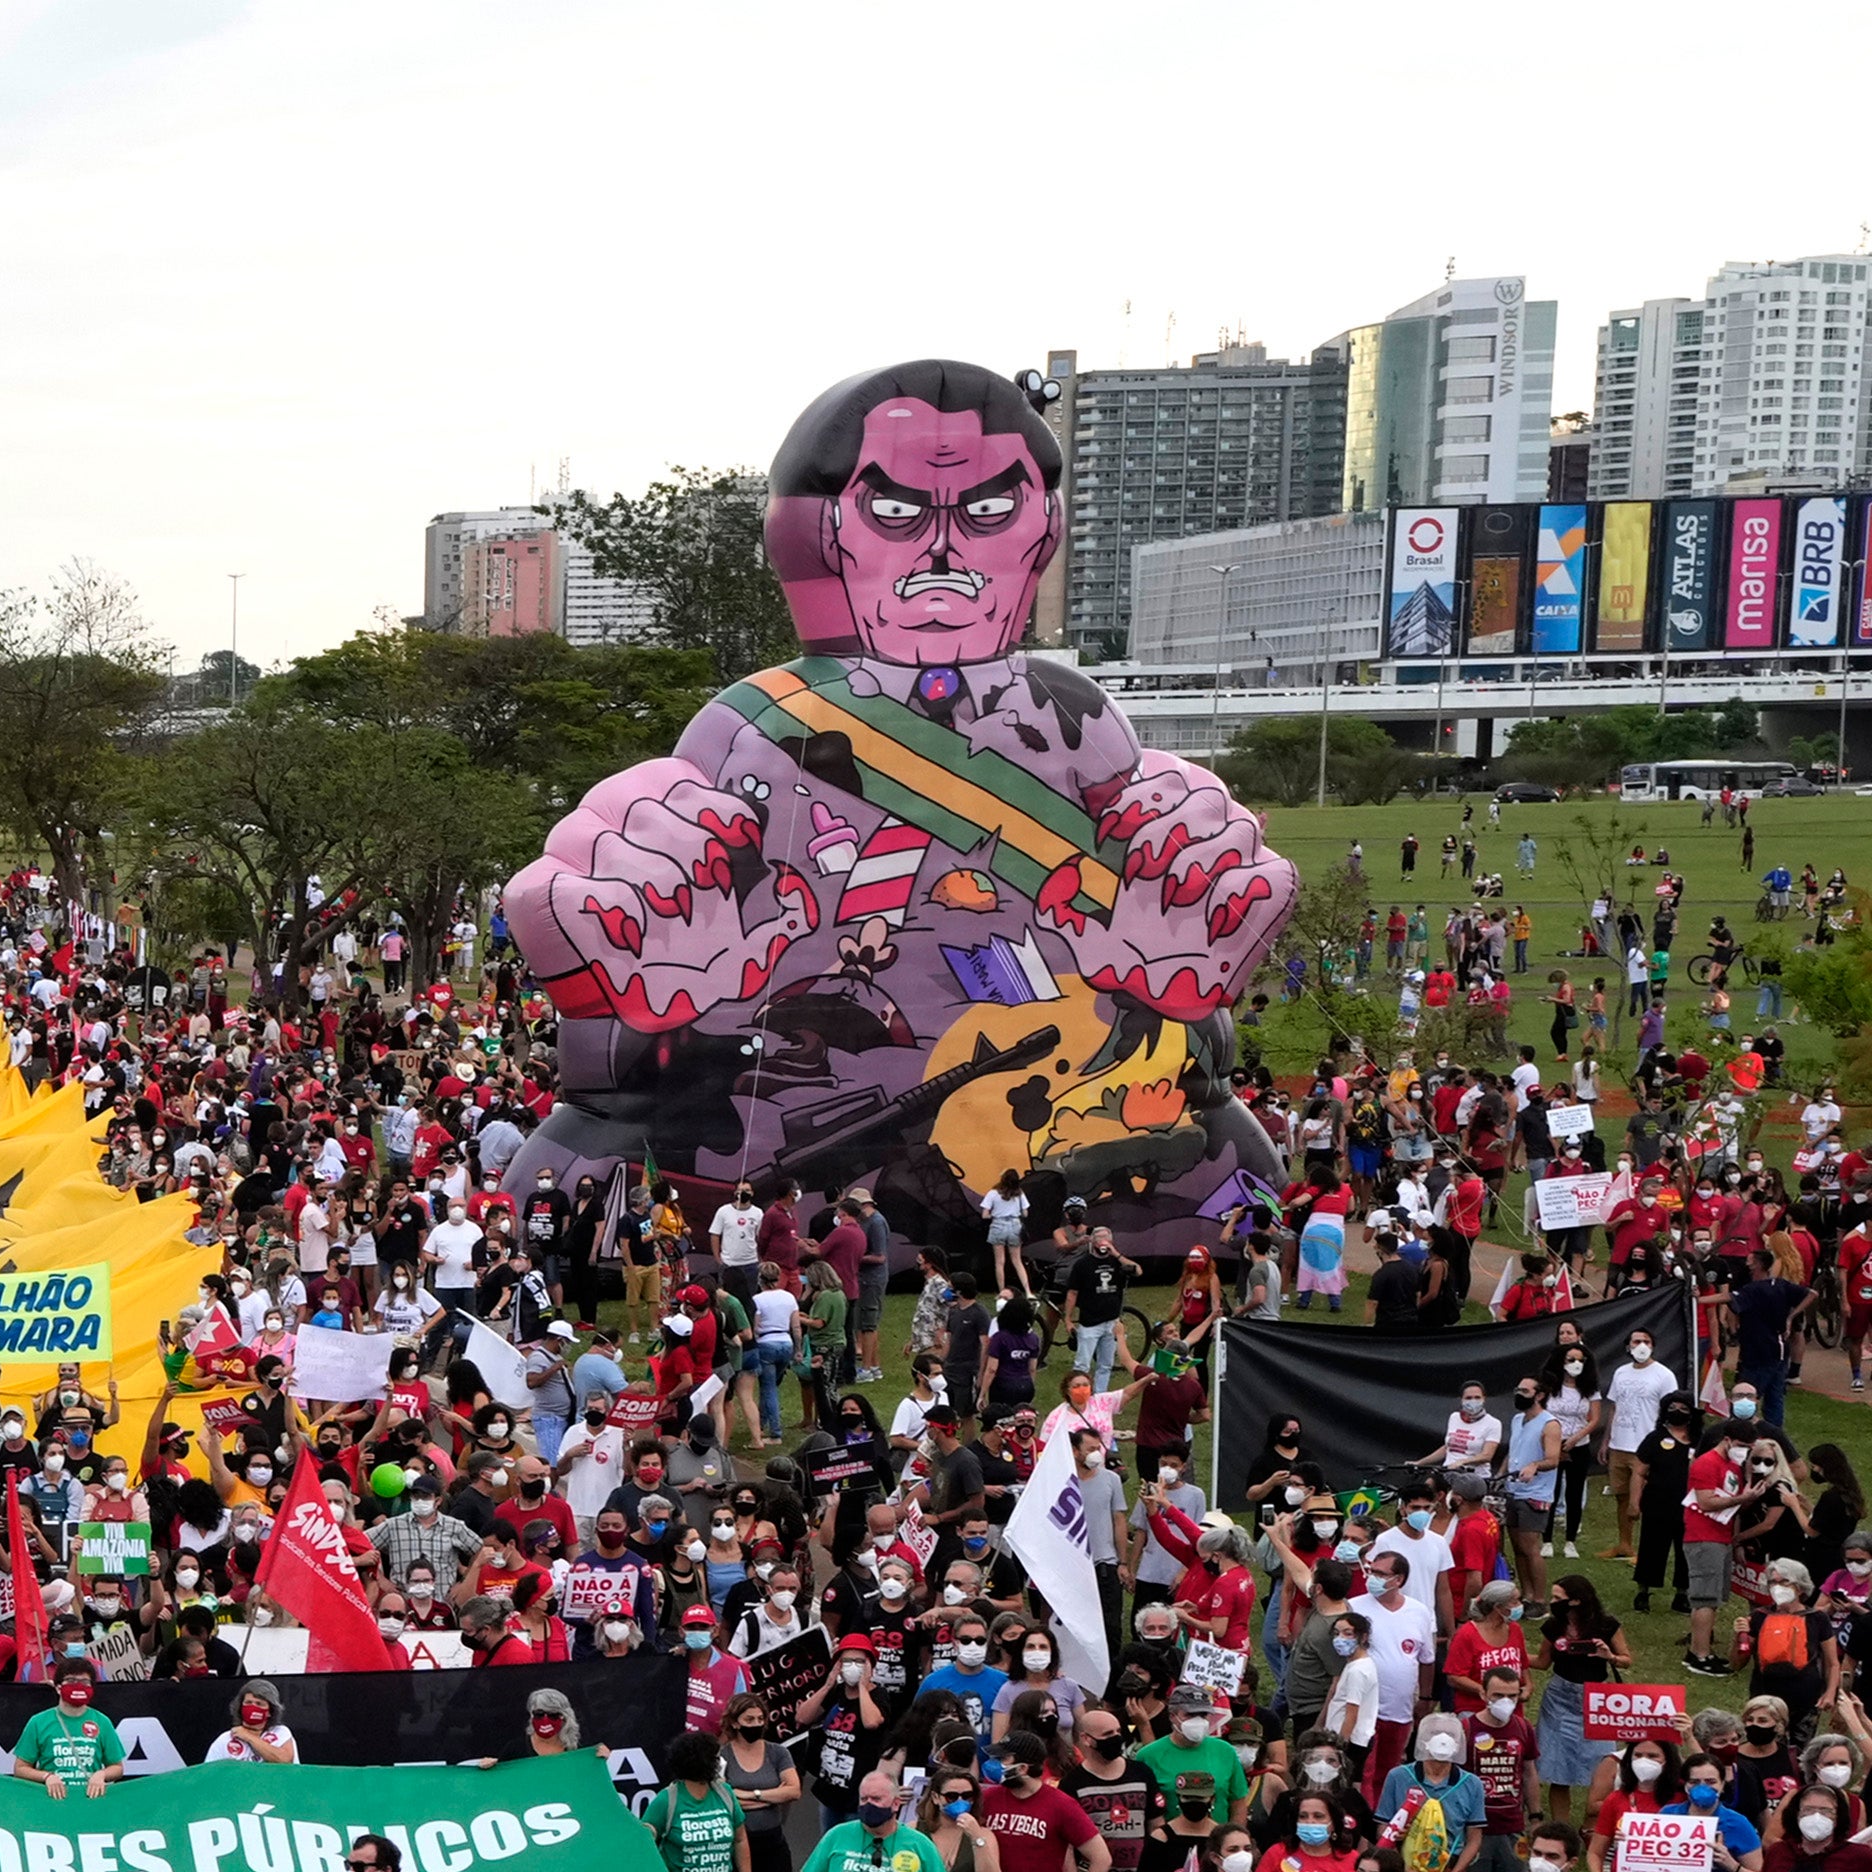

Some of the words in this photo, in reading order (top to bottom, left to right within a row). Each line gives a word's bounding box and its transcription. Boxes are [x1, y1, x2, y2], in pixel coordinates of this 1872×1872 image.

[1406, 554, 1444, 566] Brasal
[1672, 514, 1697, 600] ATLAS
[1801, 519, 1834, 588] BRB
[1737, 516, 1771, 631] marisa
[1536, 604, 1579, 617] CAIXA
[573, 1576, 612, 1592] NÃO
[572, 1591, 608, 1606] PEC
[1589, 1692, 1674, 1716] FORA
[1588, 1713, 1676, 1729] BOLSONARO
[680, 1817, 735, 1840] floresta
[986, 1813, 1010, 1833] LAS
[1012, 1816, 1048, 1840] VEGAS
[1627, 1819, 1682, 1839] NÃO
[1624, 1840, 1669, 1859] PEC
[1673, 1841, 1706, 1859] 32
